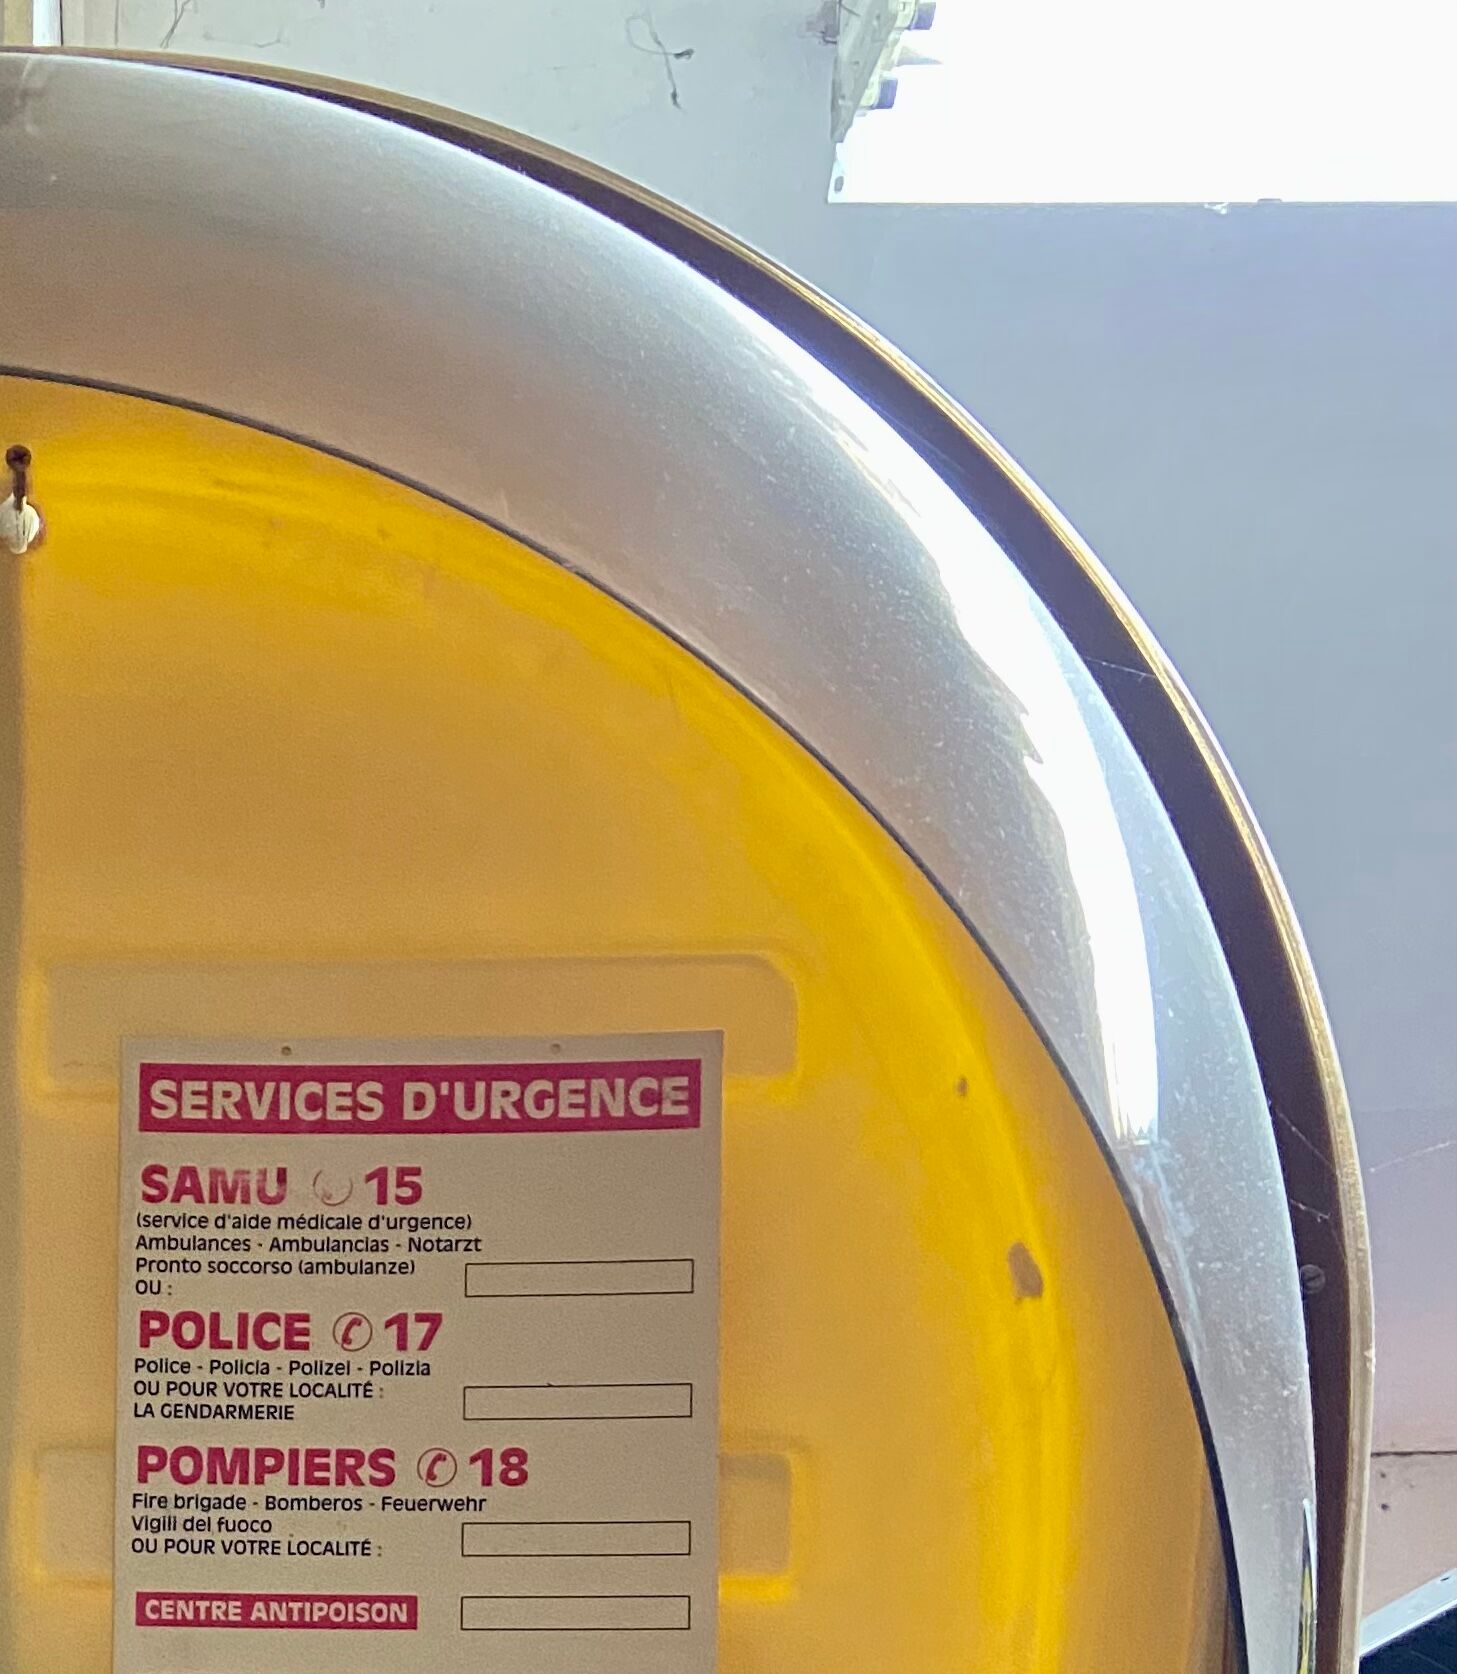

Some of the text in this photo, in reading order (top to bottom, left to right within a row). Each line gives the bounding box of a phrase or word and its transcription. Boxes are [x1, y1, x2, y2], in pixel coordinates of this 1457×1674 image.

[150, 1076, 690, 1122] SERVICES D'URGENCE
[141, 1163, 423, 1206] SAMU 15
[136, 1211, 472, 1233] (service d'aide médicale d'urgence)
[135, 1234, 251, 1253] Ambulances
[268, 1236, 390, 1254] Ambulancias
[407, 1236, 483, 1253] Notarzt
[135, 1257, 416, 1276] Pronto soccorso (ambulanze)
[135, 1279, 162, 1296] OU
[139, 1310, 443, 1353] POLICE 17
[134, 1357, 191, 1375] Police
[209, 1359, 270, 1376] Policia
[288, 1359, 351, 1376] Polizei
[369, 1359, 431, 1377] Polizia
[133, 1379, 160, 1396] OU
[166, 1380, 218, 1398] POUR
[222, 1381, 284, 1399] VOTRE
[289, 1380, 374, 1399] LOCALITÉ
[133, 1402, 295, 1421] LA GENDARMERIE
[137, 1445, 529, 1488] POMPIERS 18
[132, 1492, 169, 1510] Fire
[173, 1493, 247, 1514] brigade
[265, 1495, 363, 1512] Bomberos
[381, 1495, 488, 1512] Feuerwehr
[131, 1514, 273, 1534] Vigili del fuoco
[131, 1537, 158, 1554] OU
[164, 1538, 216, 1555] POUR
[220, 1539, 281, 1556] VOTRE
[287, 1538, 372, 1557] LOCALITÉ
[144, 1598, 408, 1623] CENTRE ANTIPOISON
